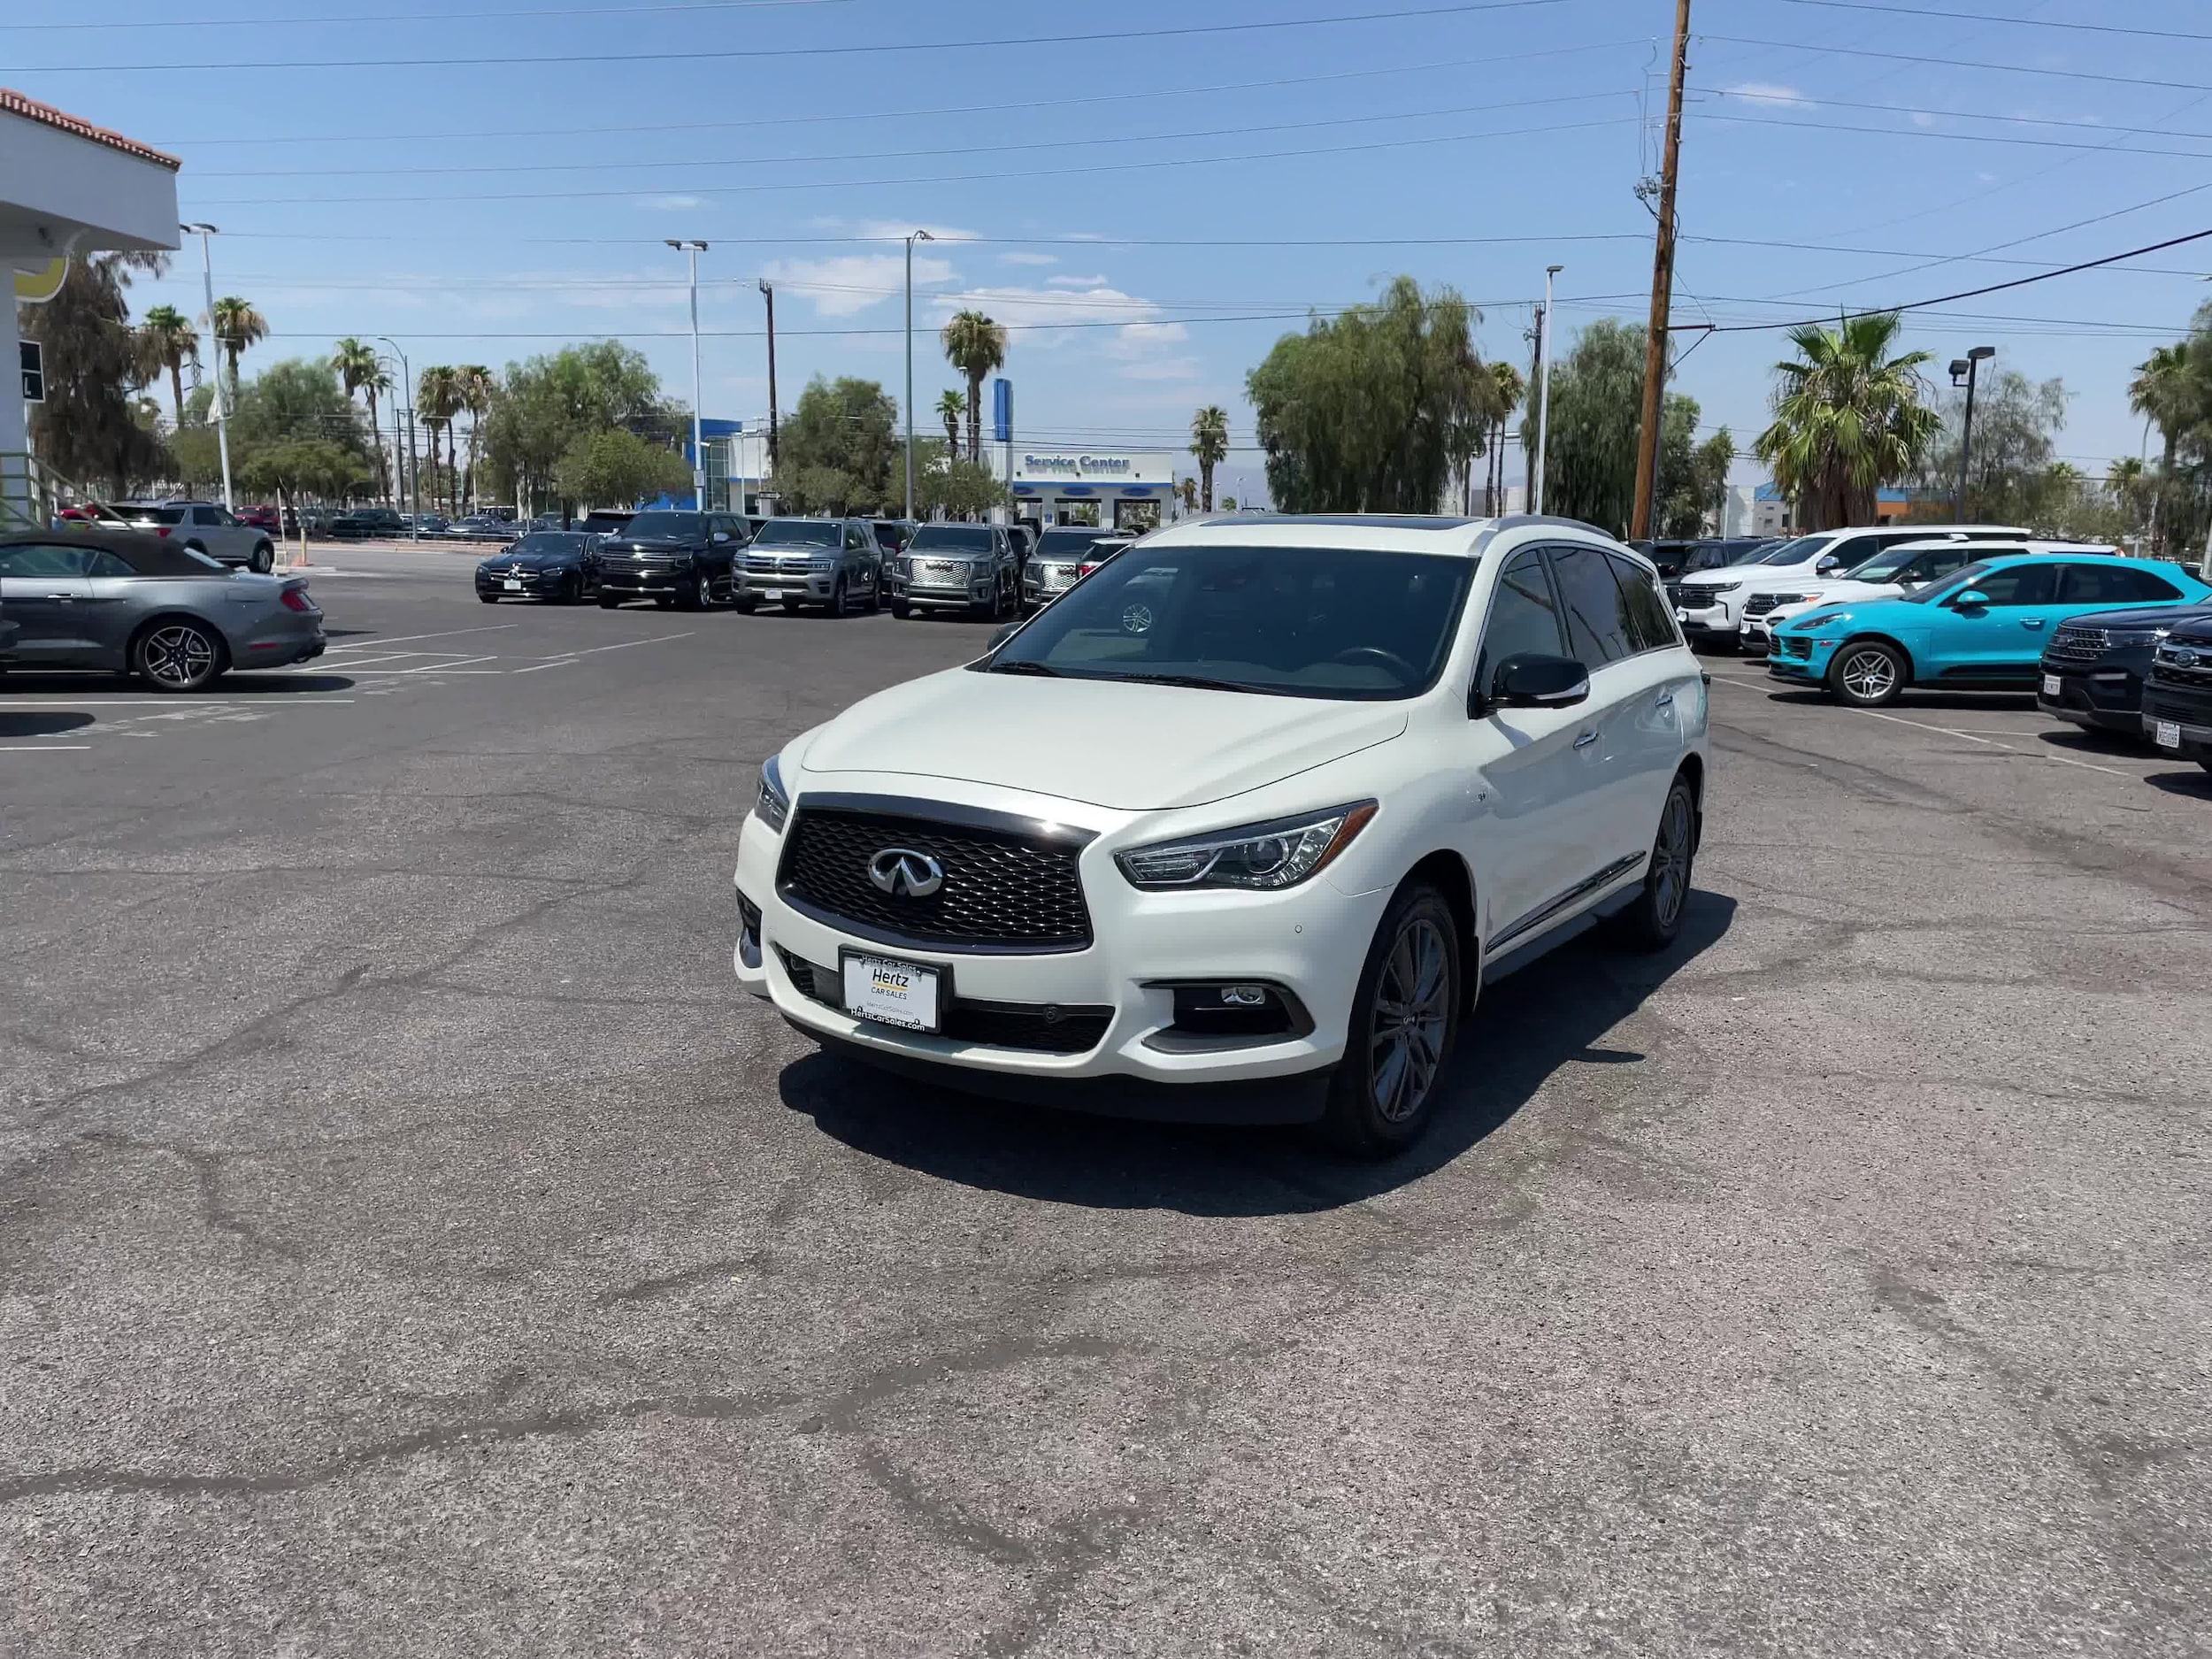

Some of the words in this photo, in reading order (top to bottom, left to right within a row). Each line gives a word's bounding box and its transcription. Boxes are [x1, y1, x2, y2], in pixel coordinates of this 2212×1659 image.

[1025, 454, 1075, 466] Service
[1079, 456, 1129, 467] Center
[872, 968, 909, 987] Hertz
[886, 989, 907, 1000] SALES
[850, 1009, 925, 1031] HertzCarSales.com
